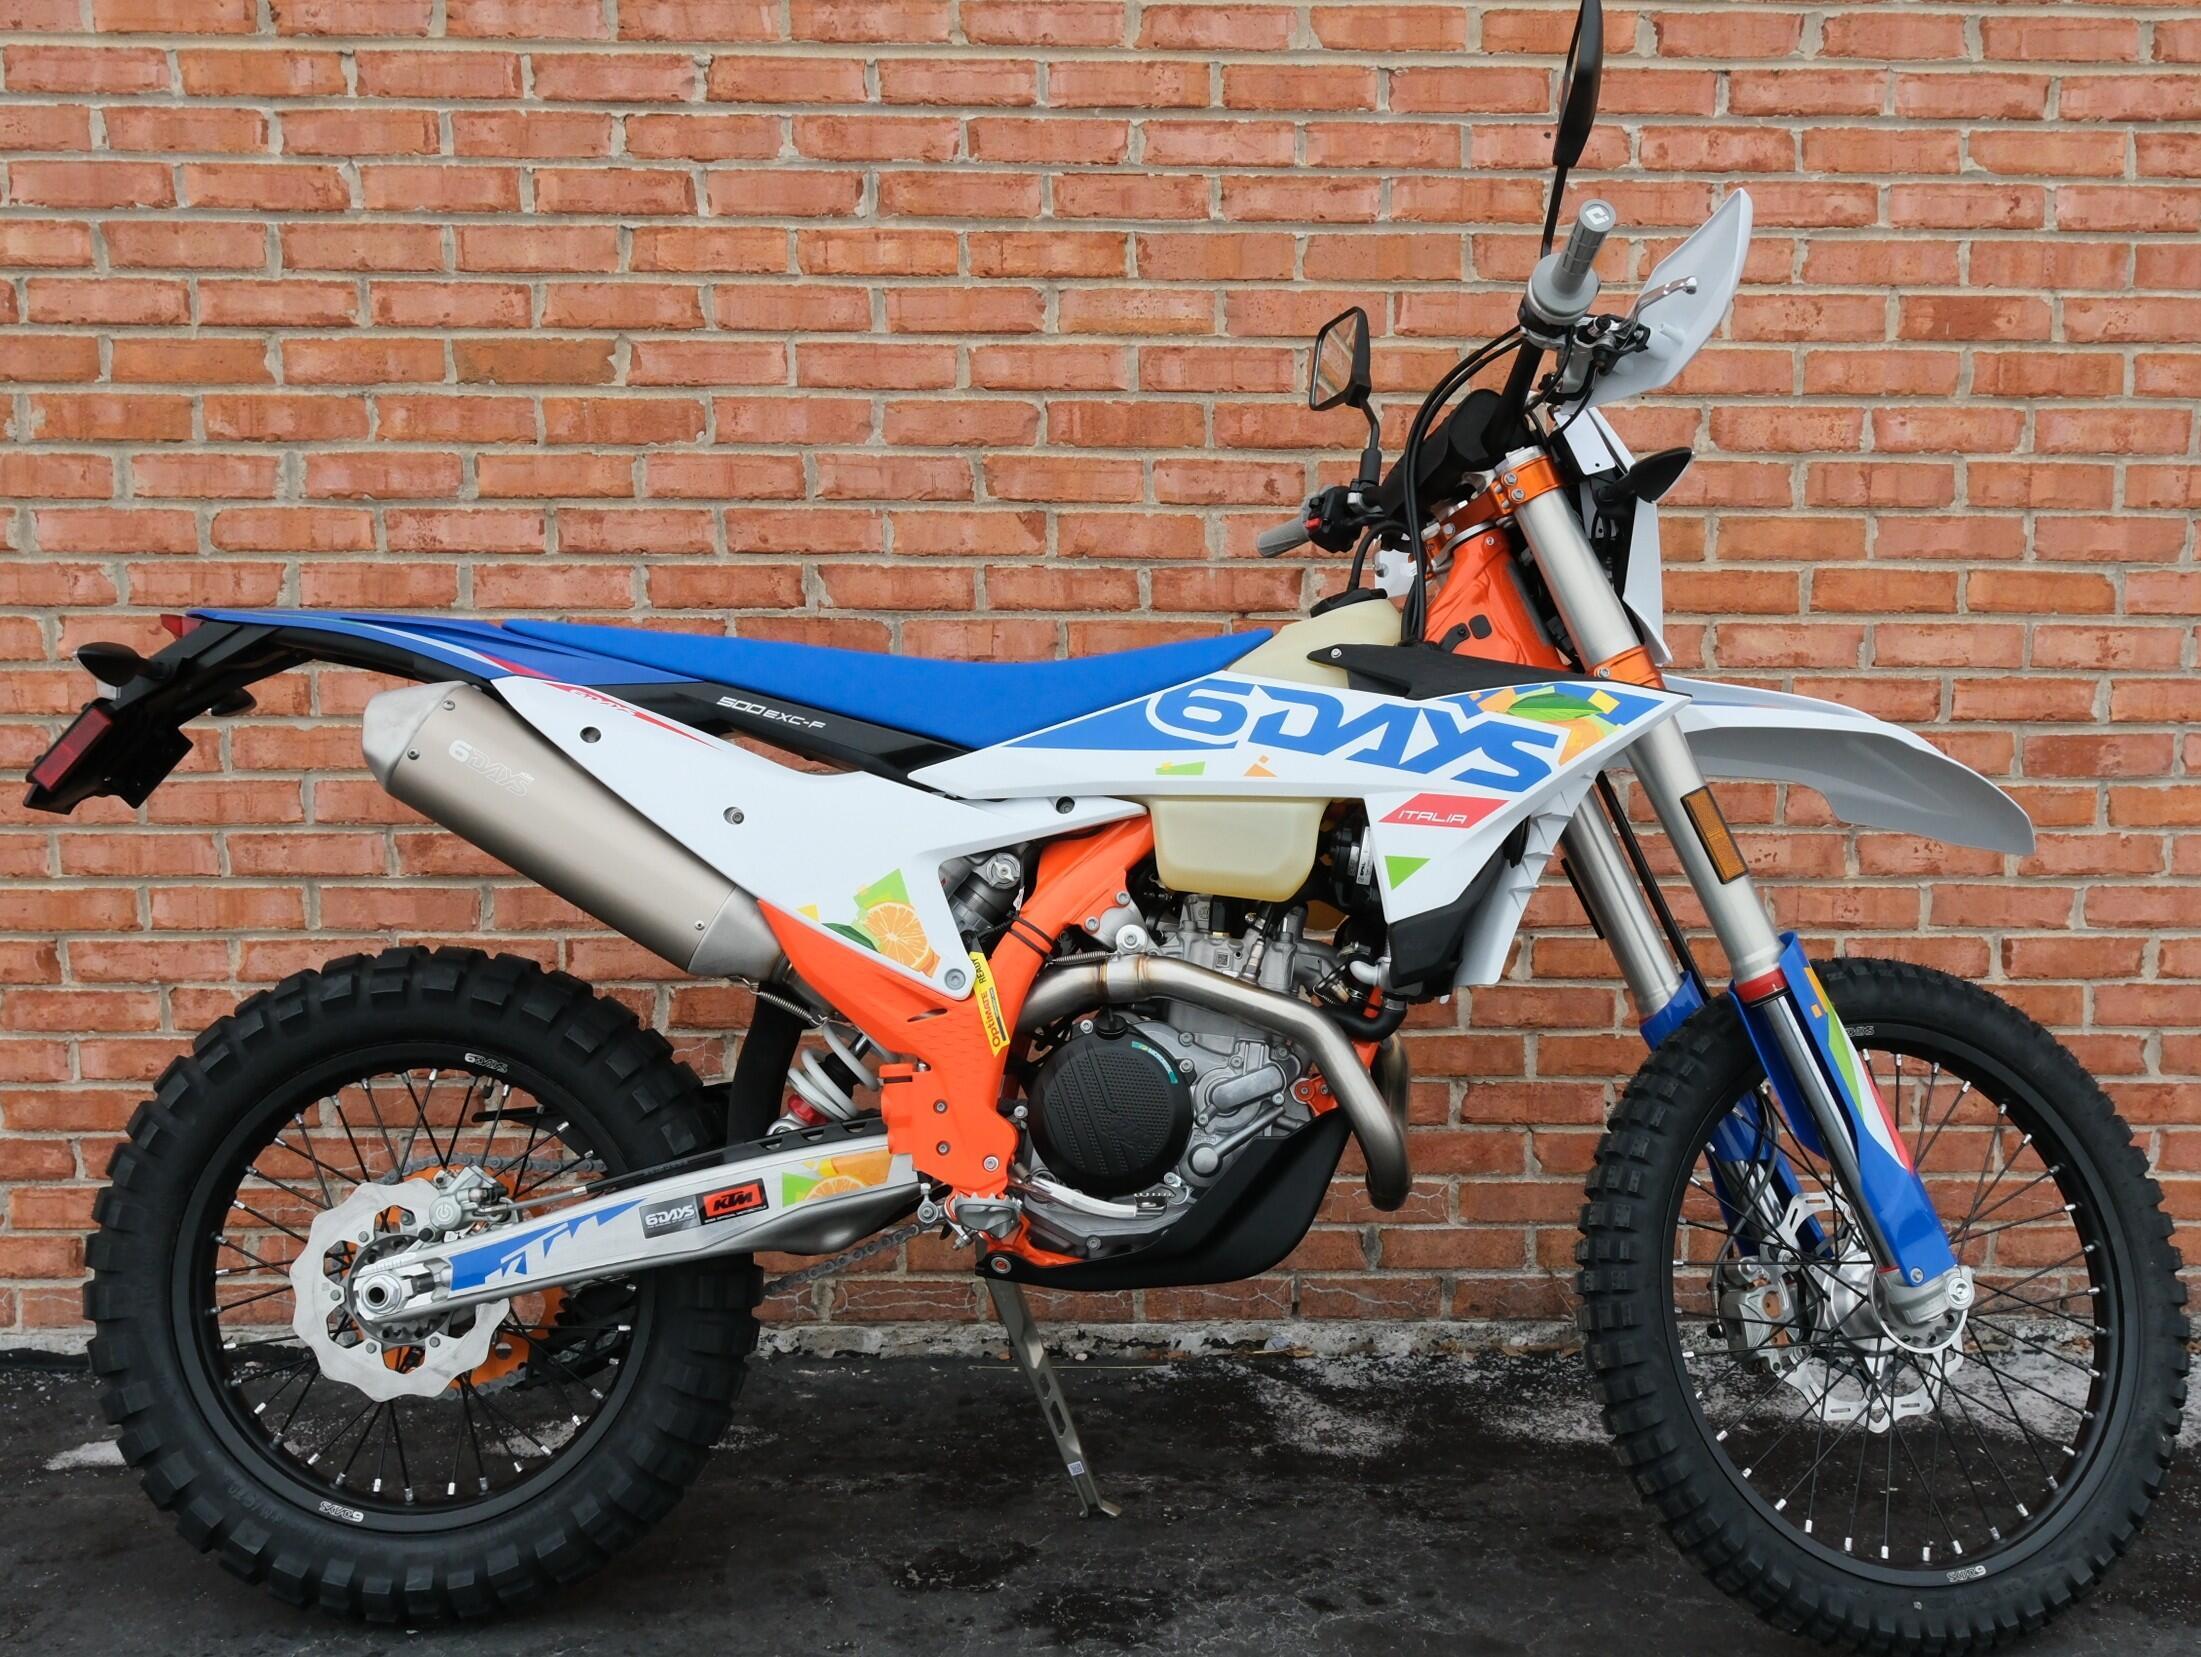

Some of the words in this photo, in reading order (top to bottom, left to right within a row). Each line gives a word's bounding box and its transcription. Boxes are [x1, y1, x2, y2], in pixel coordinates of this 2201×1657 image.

[1155, 679, 1559, 793] 6DAYS
[449, 739, 535, 798] 6DAYS
[1398, 810, 1467, 824] ITALIA
[971, 958, 987, 984] READY
[713, 1191, 753, 1212] KTM
[645, 1204, 695, 1226] 6DAYS
